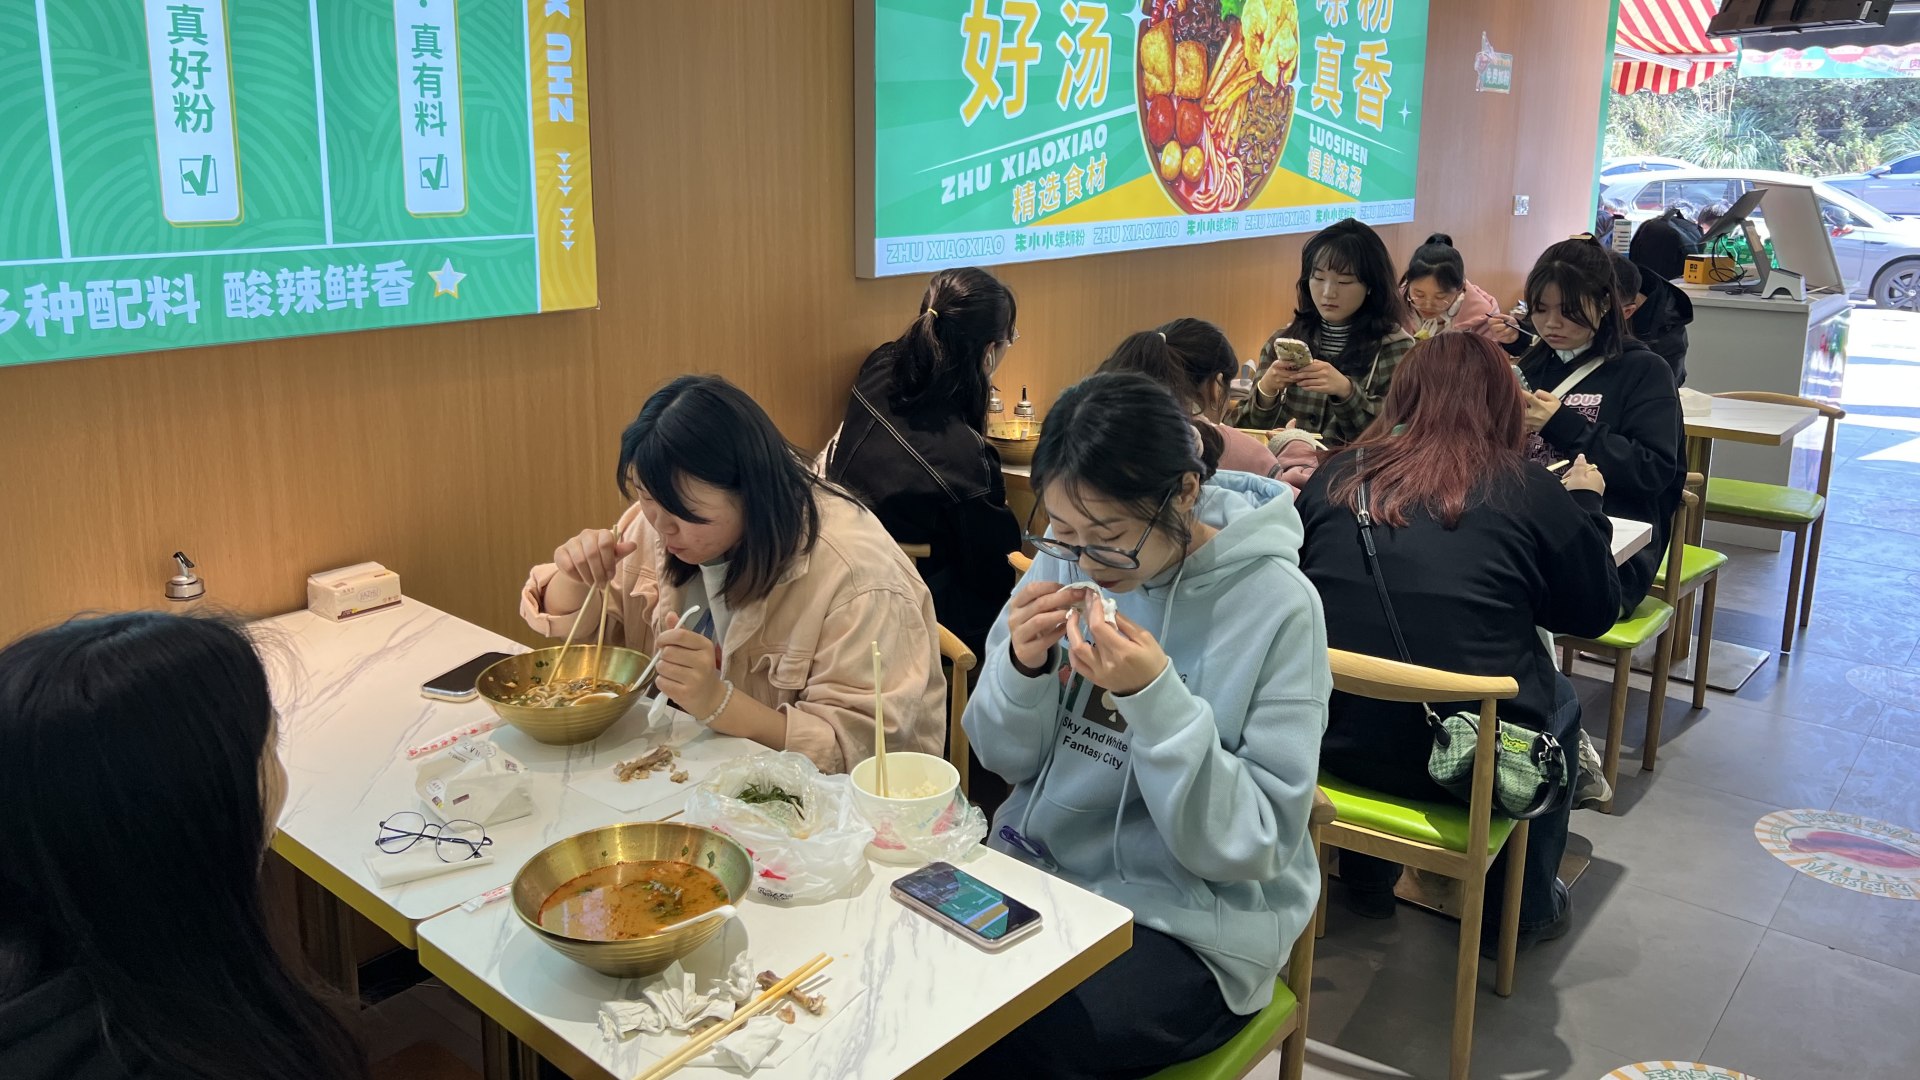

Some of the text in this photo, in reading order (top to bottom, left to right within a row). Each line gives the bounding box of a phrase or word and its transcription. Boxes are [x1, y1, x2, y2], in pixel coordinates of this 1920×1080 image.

[166, 3, 216, 134] 真好粉
[410, 23, 448, 137] 真有料
[960, 0, 1112, 127] 好汤
[1311, 32, 1392, 132] 真香
[941, 123, 1108, 205] ZHU XIAOXIAO
[1309, 122, 1368, 166] LUOSIFEN
[1012, 151, 1108, 225] 精选食材
[887, 242, 923, 264] ZHU
[926, 235, 1005, 261] XIAOXIAO
[1093, 226, 1121, 244] ZHU
[1122, 220, 1180, 242] XIAOXIAO
[1245, 214, 1267, 230] ZHU
[1267, 209, 1311, 229] XIAOXIAO
[223, 260, 414, 319] 酸辣鲜香
[1062, 716, 1128, 752] Sky And White
[1062, 735, 1124, 770] Fantasy City
